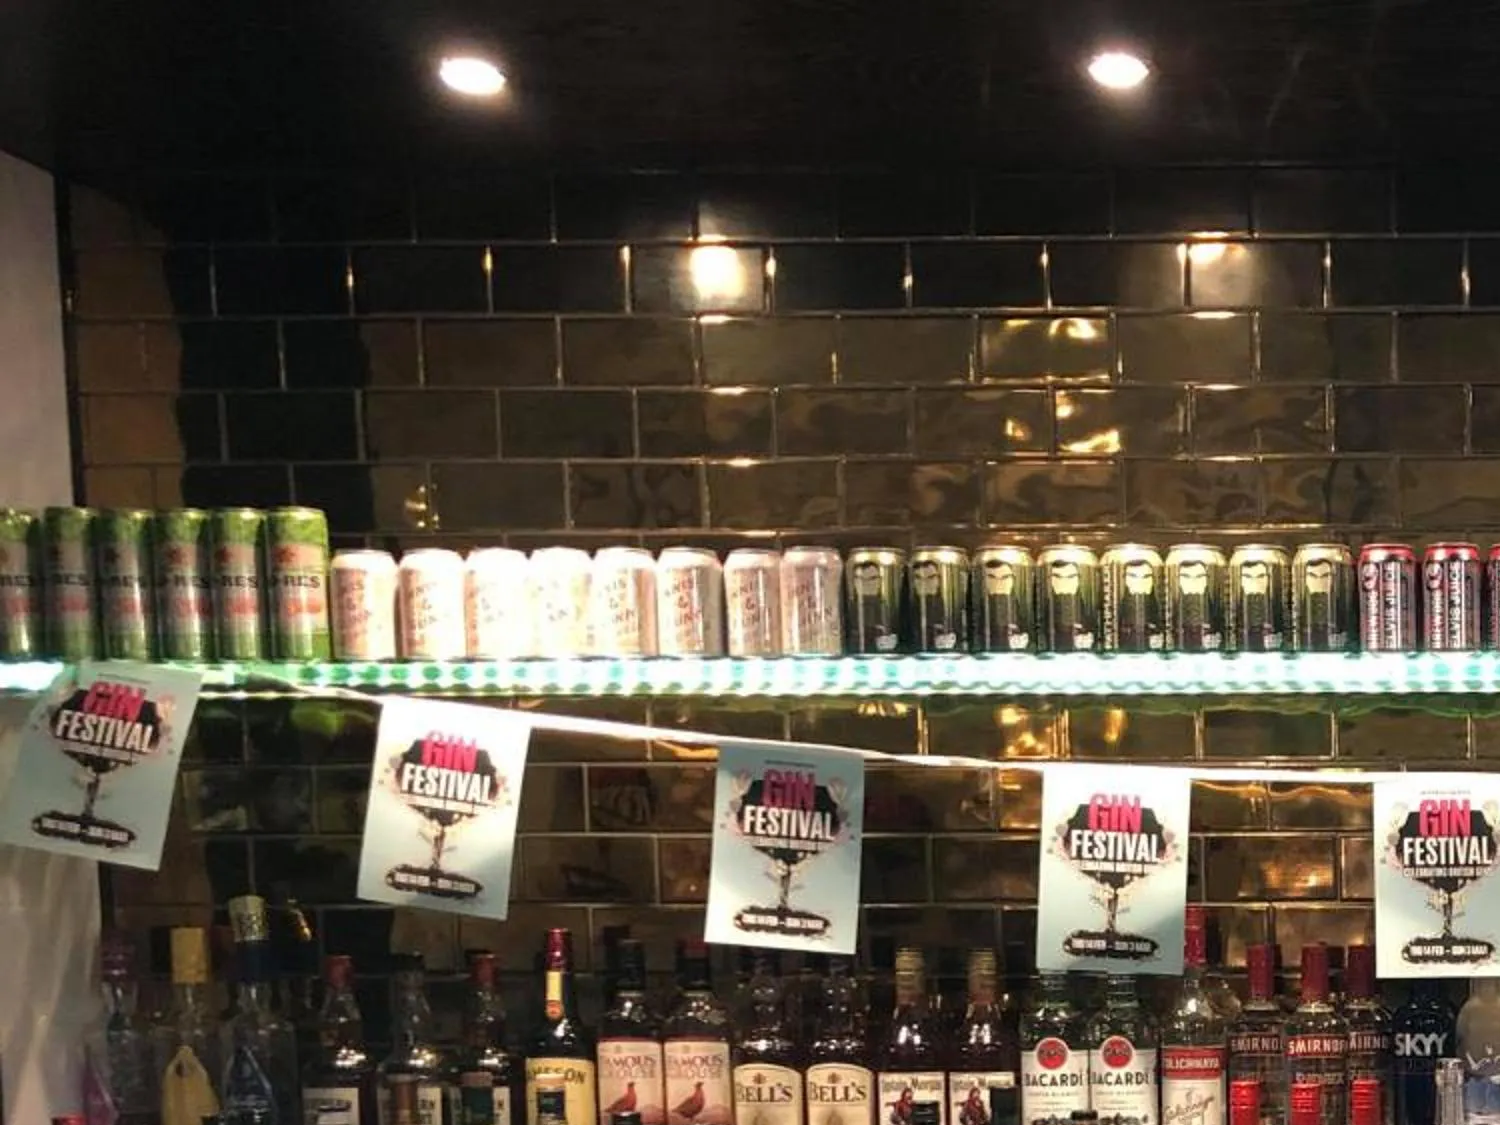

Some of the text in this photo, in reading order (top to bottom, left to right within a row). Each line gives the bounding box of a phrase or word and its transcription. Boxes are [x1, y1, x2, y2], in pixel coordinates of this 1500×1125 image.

[83, 681, 146, 722] GIN
[56, 710, 153, 753] FESTIVAL
[422, 730, 479, 772] GIN
[401, 763, 492, 802] FESTIVAL
[762, 769, 815, 810] GIN
[743, 805, 834, 841] FESTIVAL
[1088, 793, 1142, 832] GIN
[1419, 799, 1471, 836] GIN
[1070, 830, 1160, 862] FESTIVAL
[1403, 836, 1493, 865] FESTIVAL
[1231, 1035, 1283, 1050] SMIRNO
[1288, 1038, 1346, 1055] SMIRNOF
[1394, 1032, 1448, 1056] SKYY
[737, 1083, 793, 1102] BELL'S
[809, 1083, 867, 1102] BELL'S
